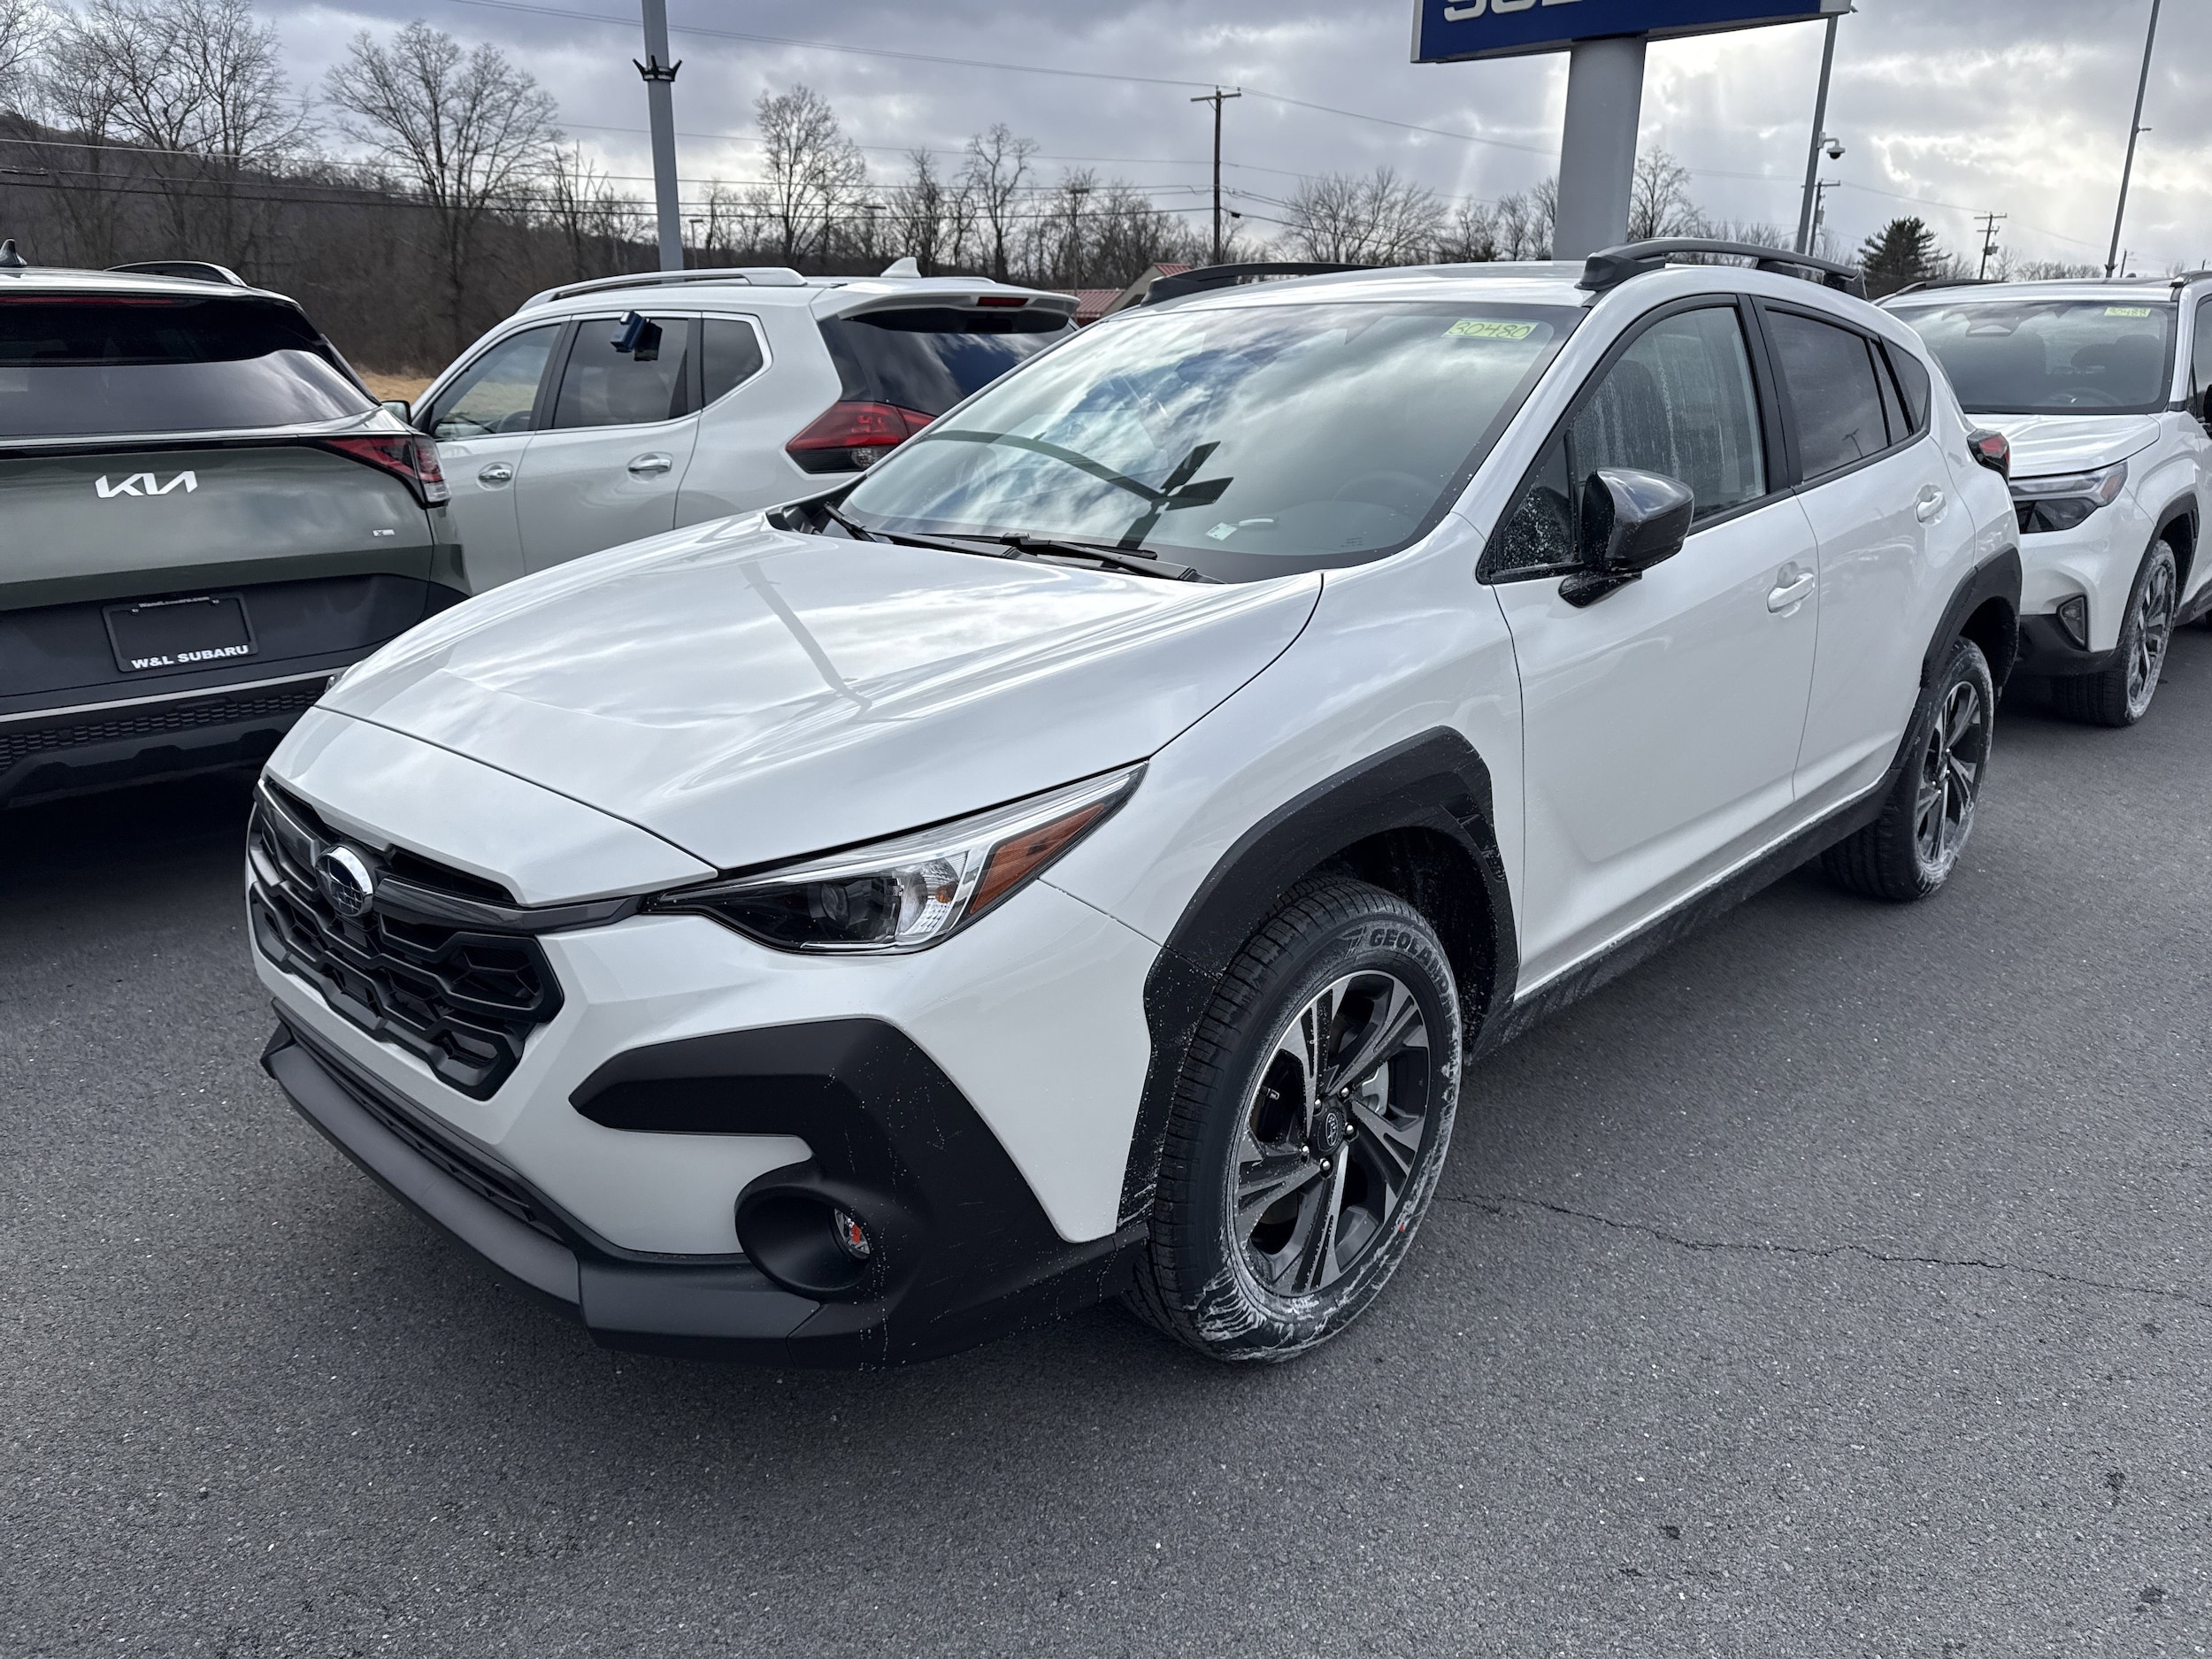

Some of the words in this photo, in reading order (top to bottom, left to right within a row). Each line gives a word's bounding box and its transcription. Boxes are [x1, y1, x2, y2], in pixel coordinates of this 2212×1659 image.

[1448, 321, 1532, 338] 30480
[95, 471, 197, 498] KIA
[131, 656, 174, 669] W&L
[177, 645, 249, 663] SUBARU
